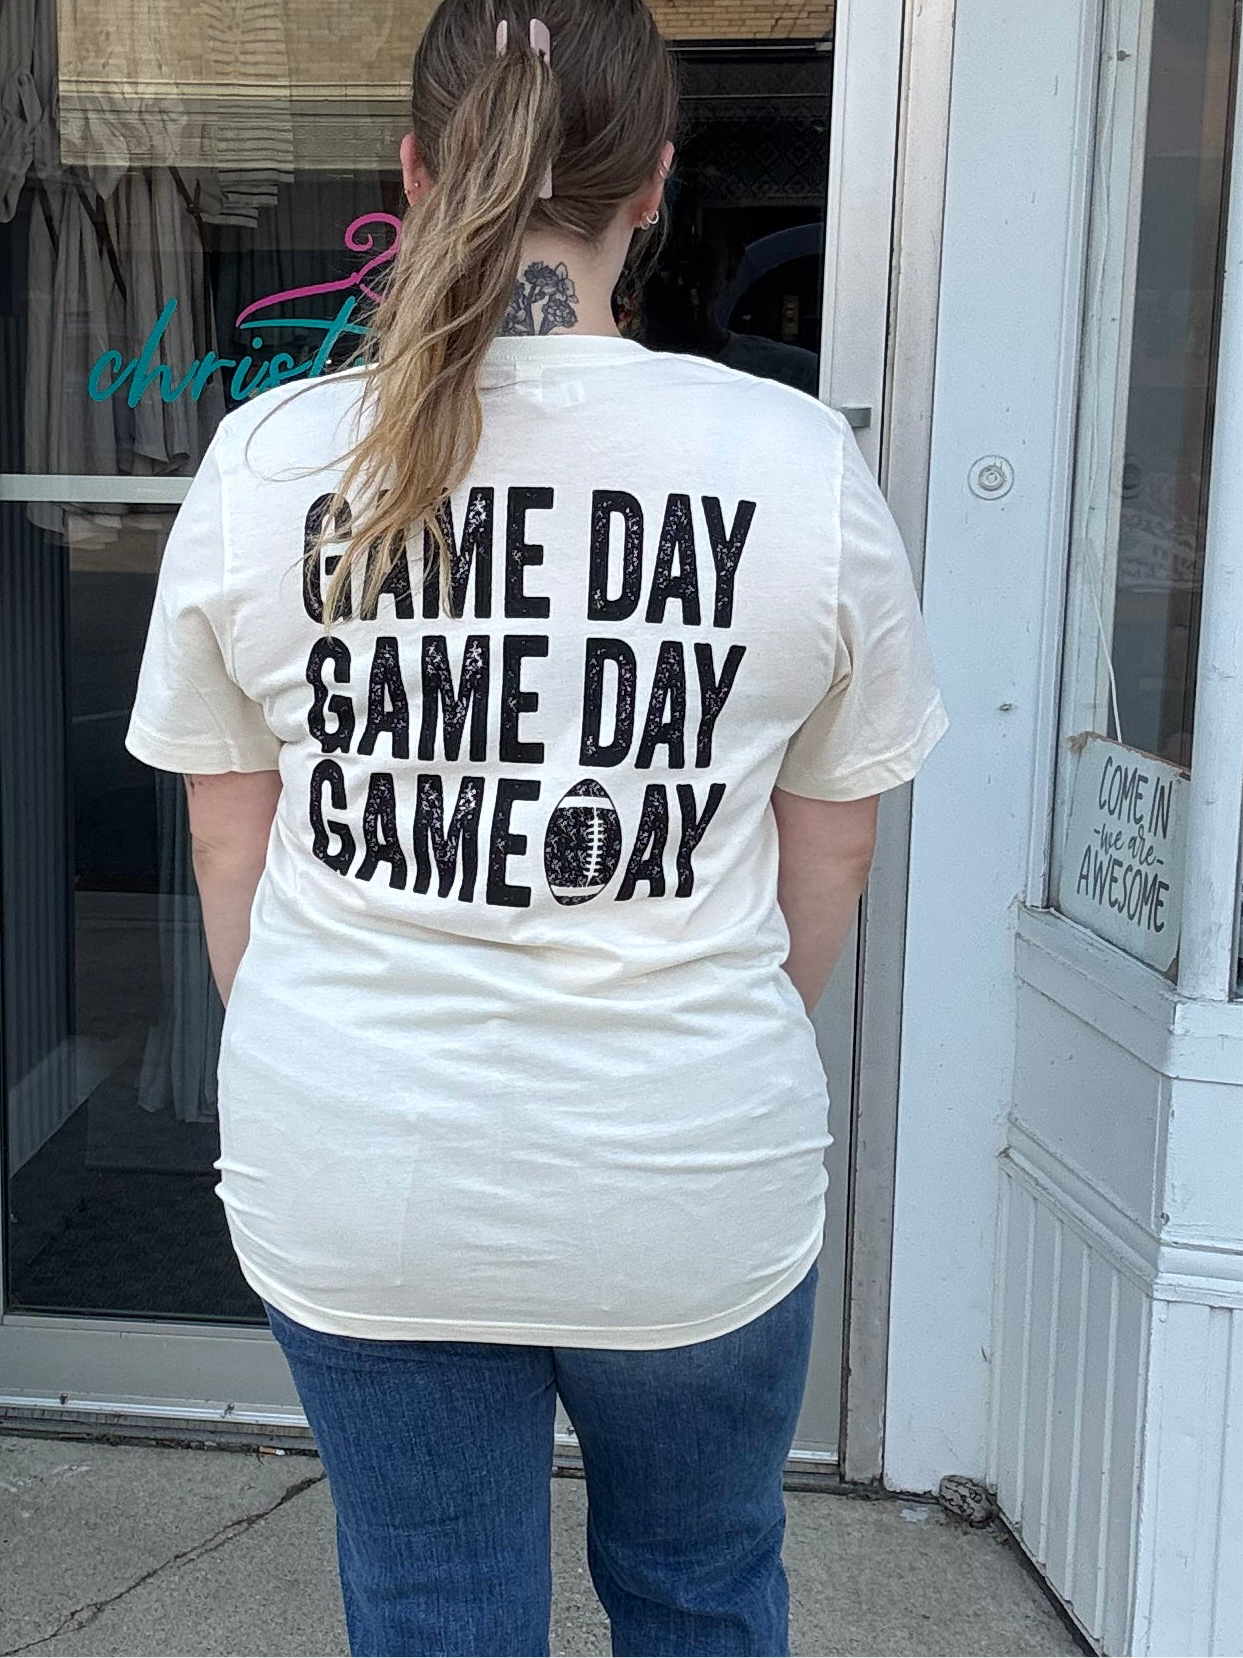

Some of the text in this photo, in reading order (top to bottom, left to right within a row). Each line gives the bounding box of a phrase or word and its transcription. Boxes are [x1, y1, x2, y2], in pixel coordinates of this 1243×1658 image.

[88, 296, 375, 408] christ
[302, 487, 757, 628] GAME DAY
[306, 634, 747, 769] GAME DAY
[310, 758, 541, 908] GAME
[1098, 755, 1173, 840] COME IN
[1076, 844, 1170, 933] AWESOME
